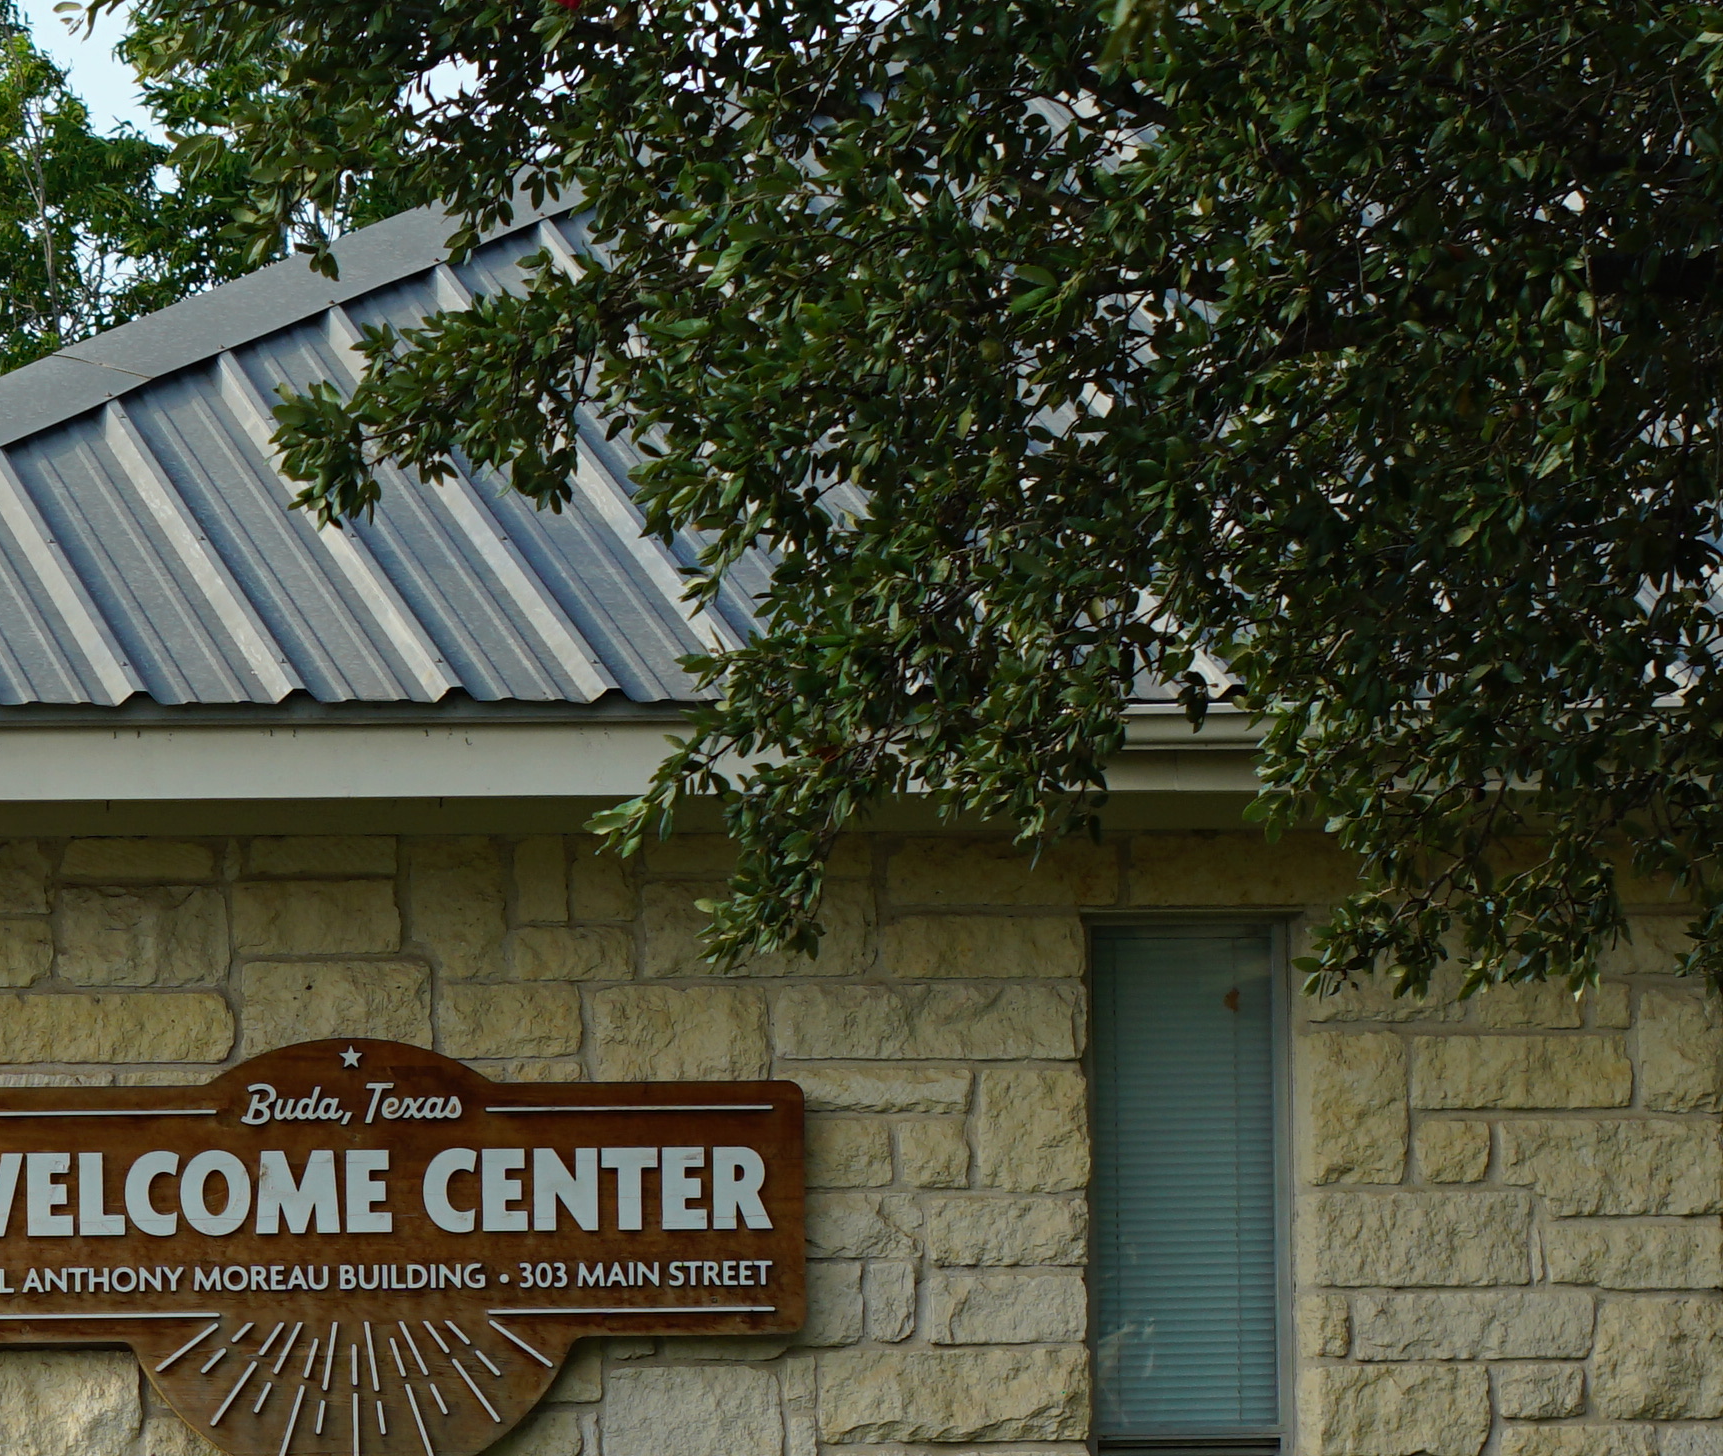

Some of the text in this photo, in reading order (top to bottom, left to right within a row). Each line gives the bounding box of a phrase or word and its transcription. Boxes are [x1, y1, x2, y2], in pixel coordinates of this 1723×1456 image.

[240, 1082, 463, 1126] Buda, Texas
[422, 1145, 774, 1234] CENTER
[22, 1265, 185, 1294] ANTHONY
[193, 1263, 330, 1292] MOREAU
[339, 1262, 487, 1291] BUILDING
[518, 1261, 569, 1289] 303
[577, 1260, 661, 1288] MAIN
[668, 1259, 774, 1287] STREET
